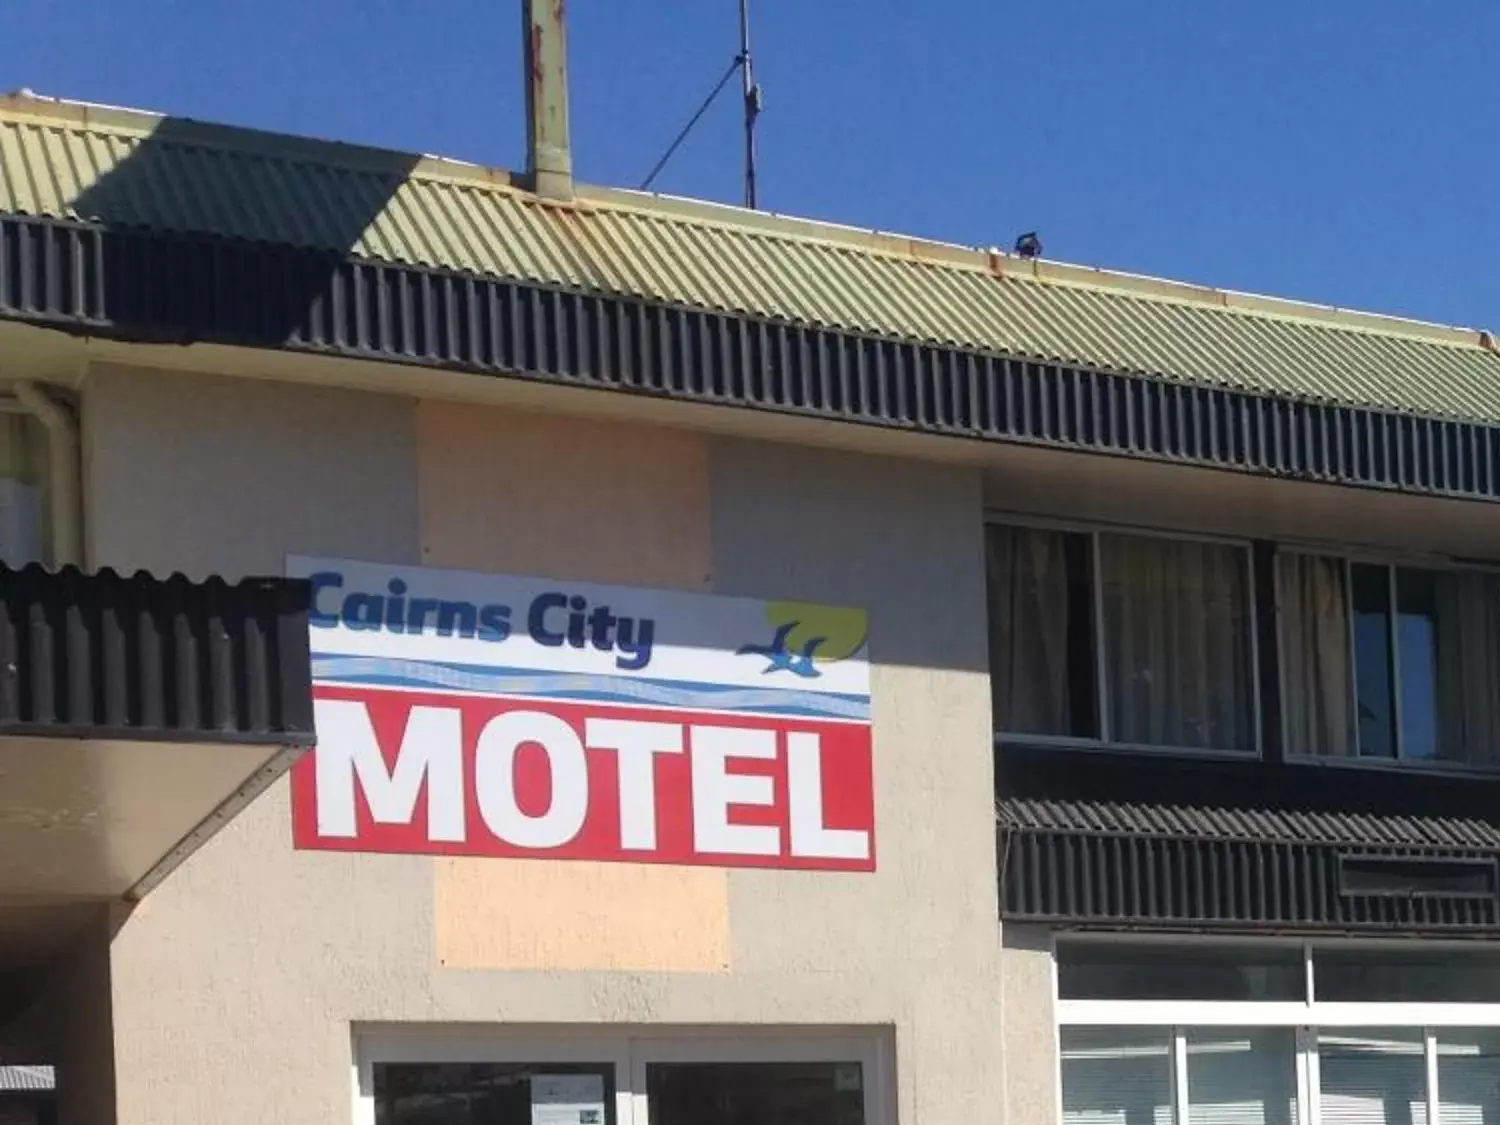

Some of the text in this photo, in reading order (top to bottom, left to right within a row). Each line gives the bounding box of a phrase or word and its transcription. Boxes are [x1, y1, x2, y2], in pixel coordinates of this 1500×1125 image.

[309, 571, 656, 671] Cairns City
[312, 698, 870, 860] MOTEL
